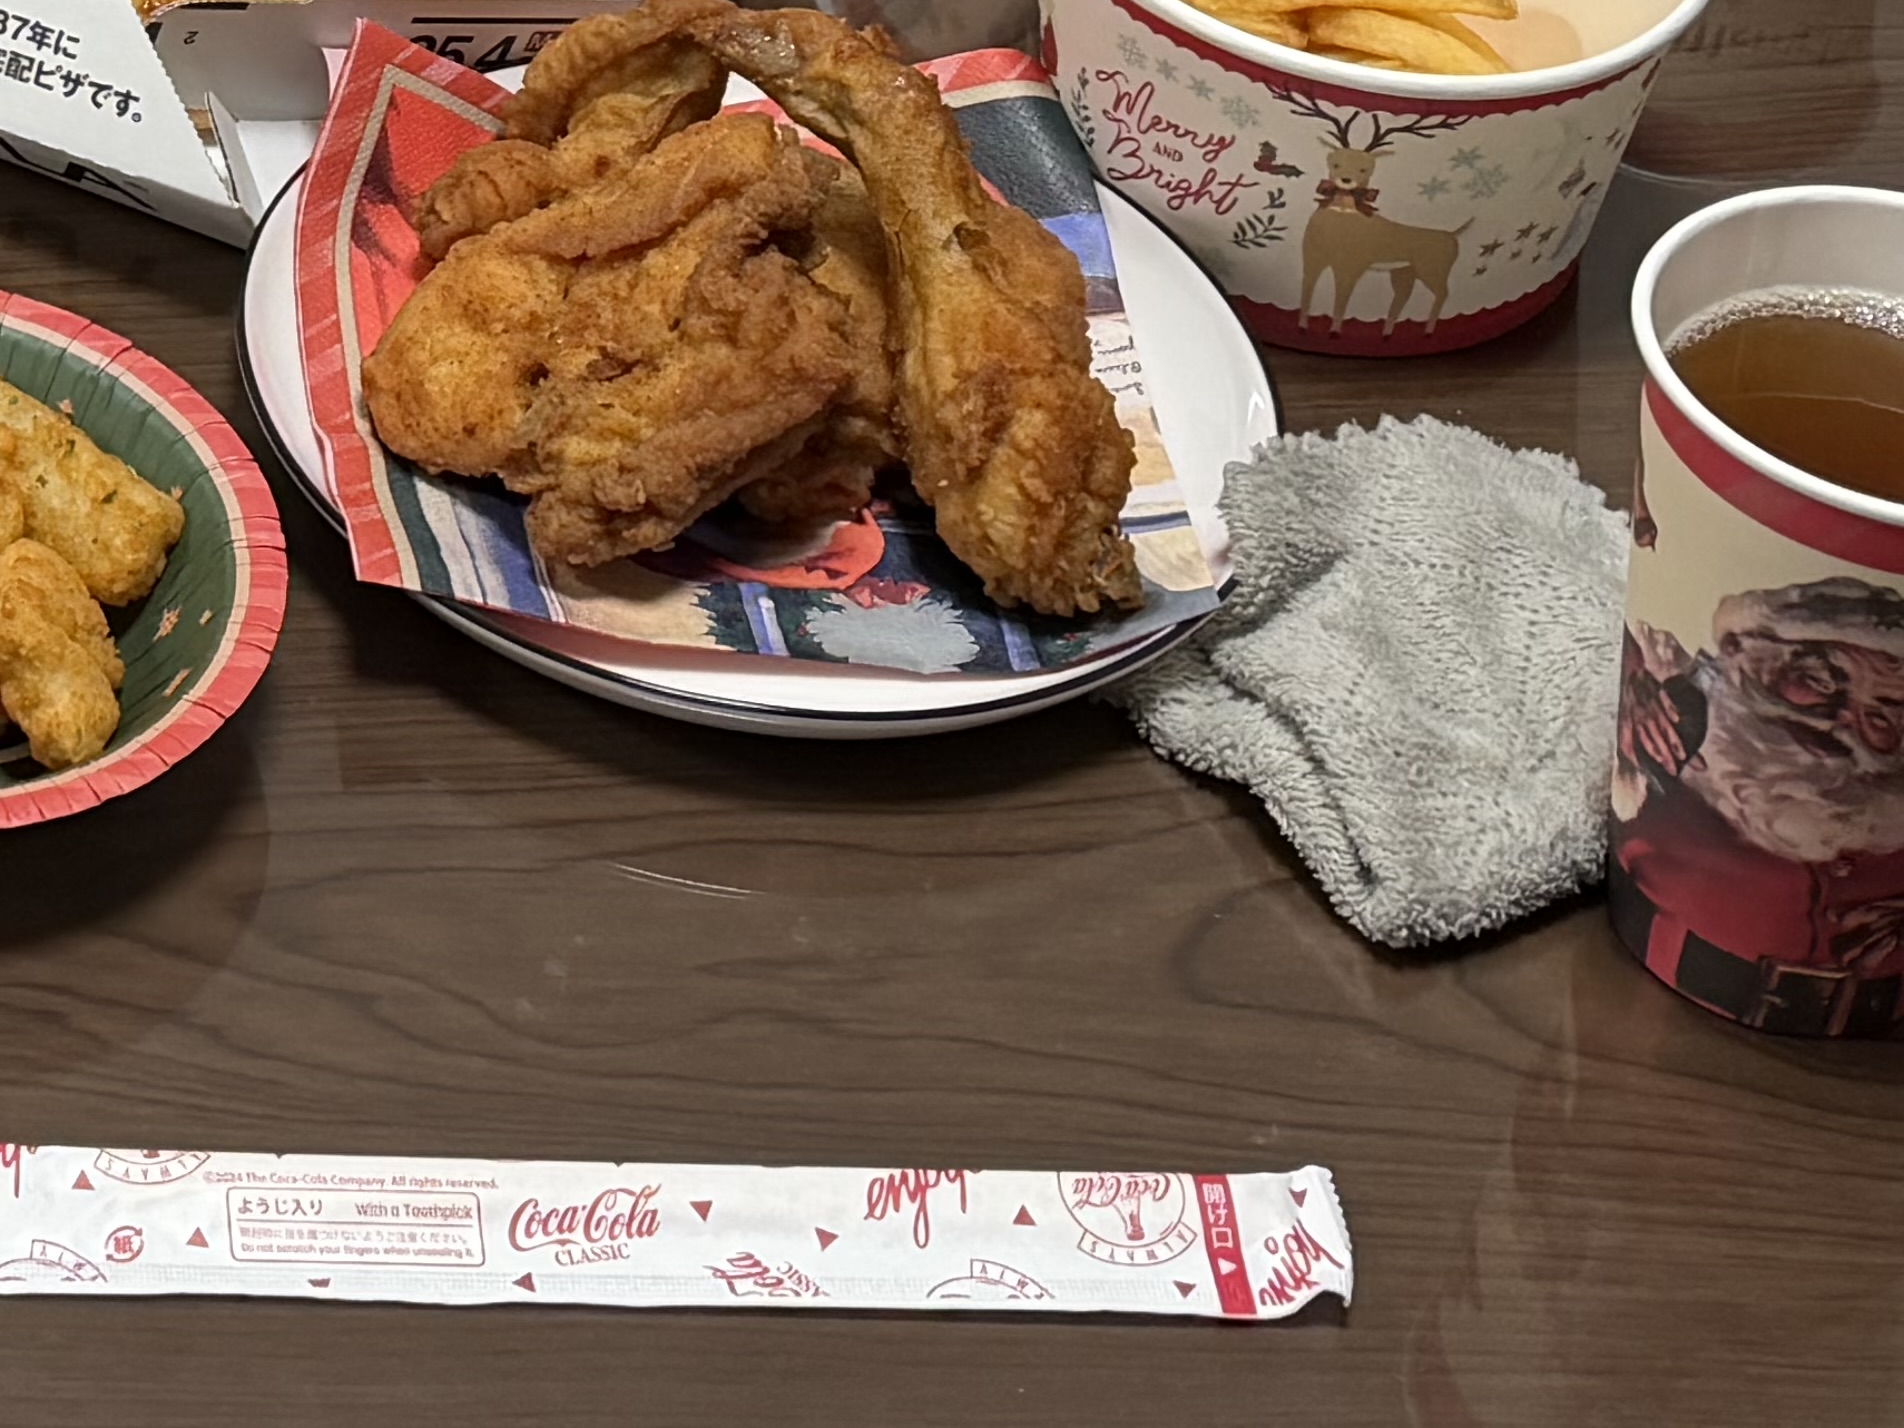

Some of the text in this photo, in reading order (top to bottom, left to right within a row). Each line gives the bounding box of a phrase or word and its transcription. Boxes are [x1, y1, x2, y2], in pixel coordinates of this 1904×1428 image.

[1095, 68, 1236, 157] Merry
[1103, 108, 1260, 216] Bright
[1153, 140, 1184, 163] AND
[238, 1197, 324, 1216] ようじ入り
[508, 1182, 662, 1253] Coca-Cola
[1201, 1182, 1235, 1250] 開け口
[555, 1242, 630, 1268] CLASSIC
